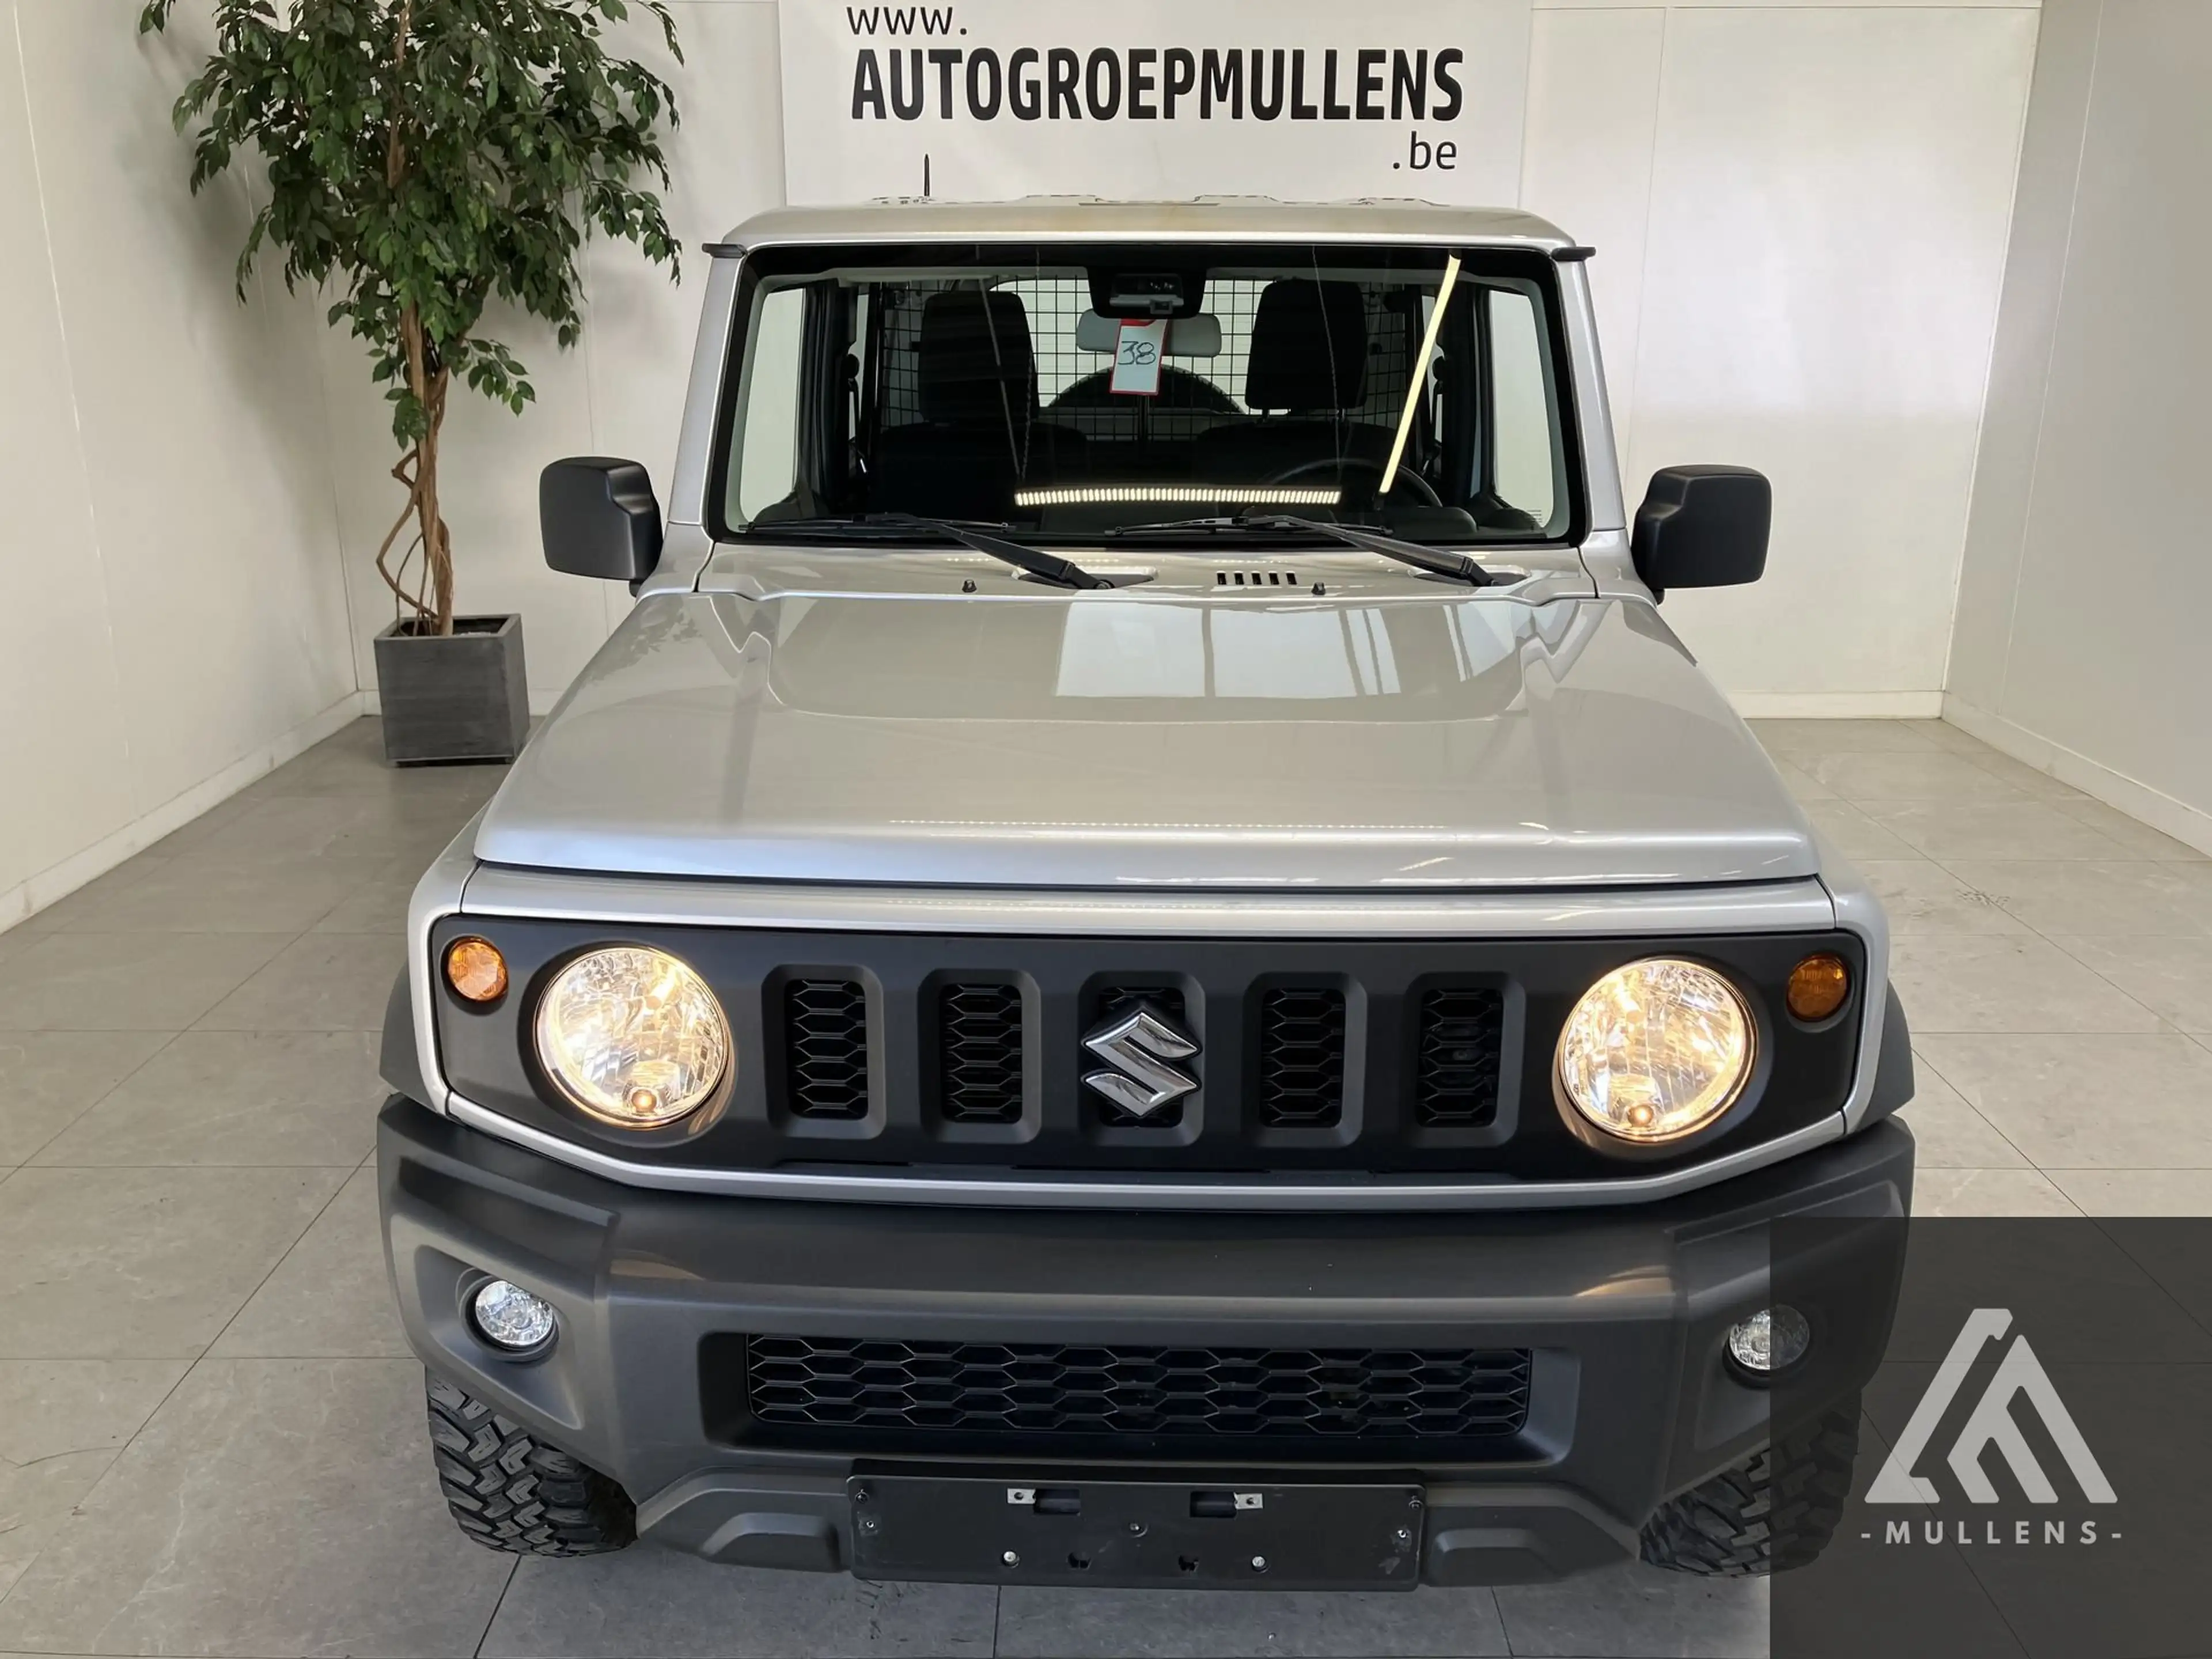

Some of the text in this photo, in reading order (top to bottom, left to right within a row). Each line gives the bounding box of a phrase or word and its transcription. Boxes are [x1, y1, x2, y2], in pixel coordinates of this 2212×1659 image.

[847, 7, 967, 35] www.
[852, 48, 1463, 121] AUTOGROEPMULLENS
[1393, 131, 1457, 170] .be
[1118, 341, 1156, 365] 38
